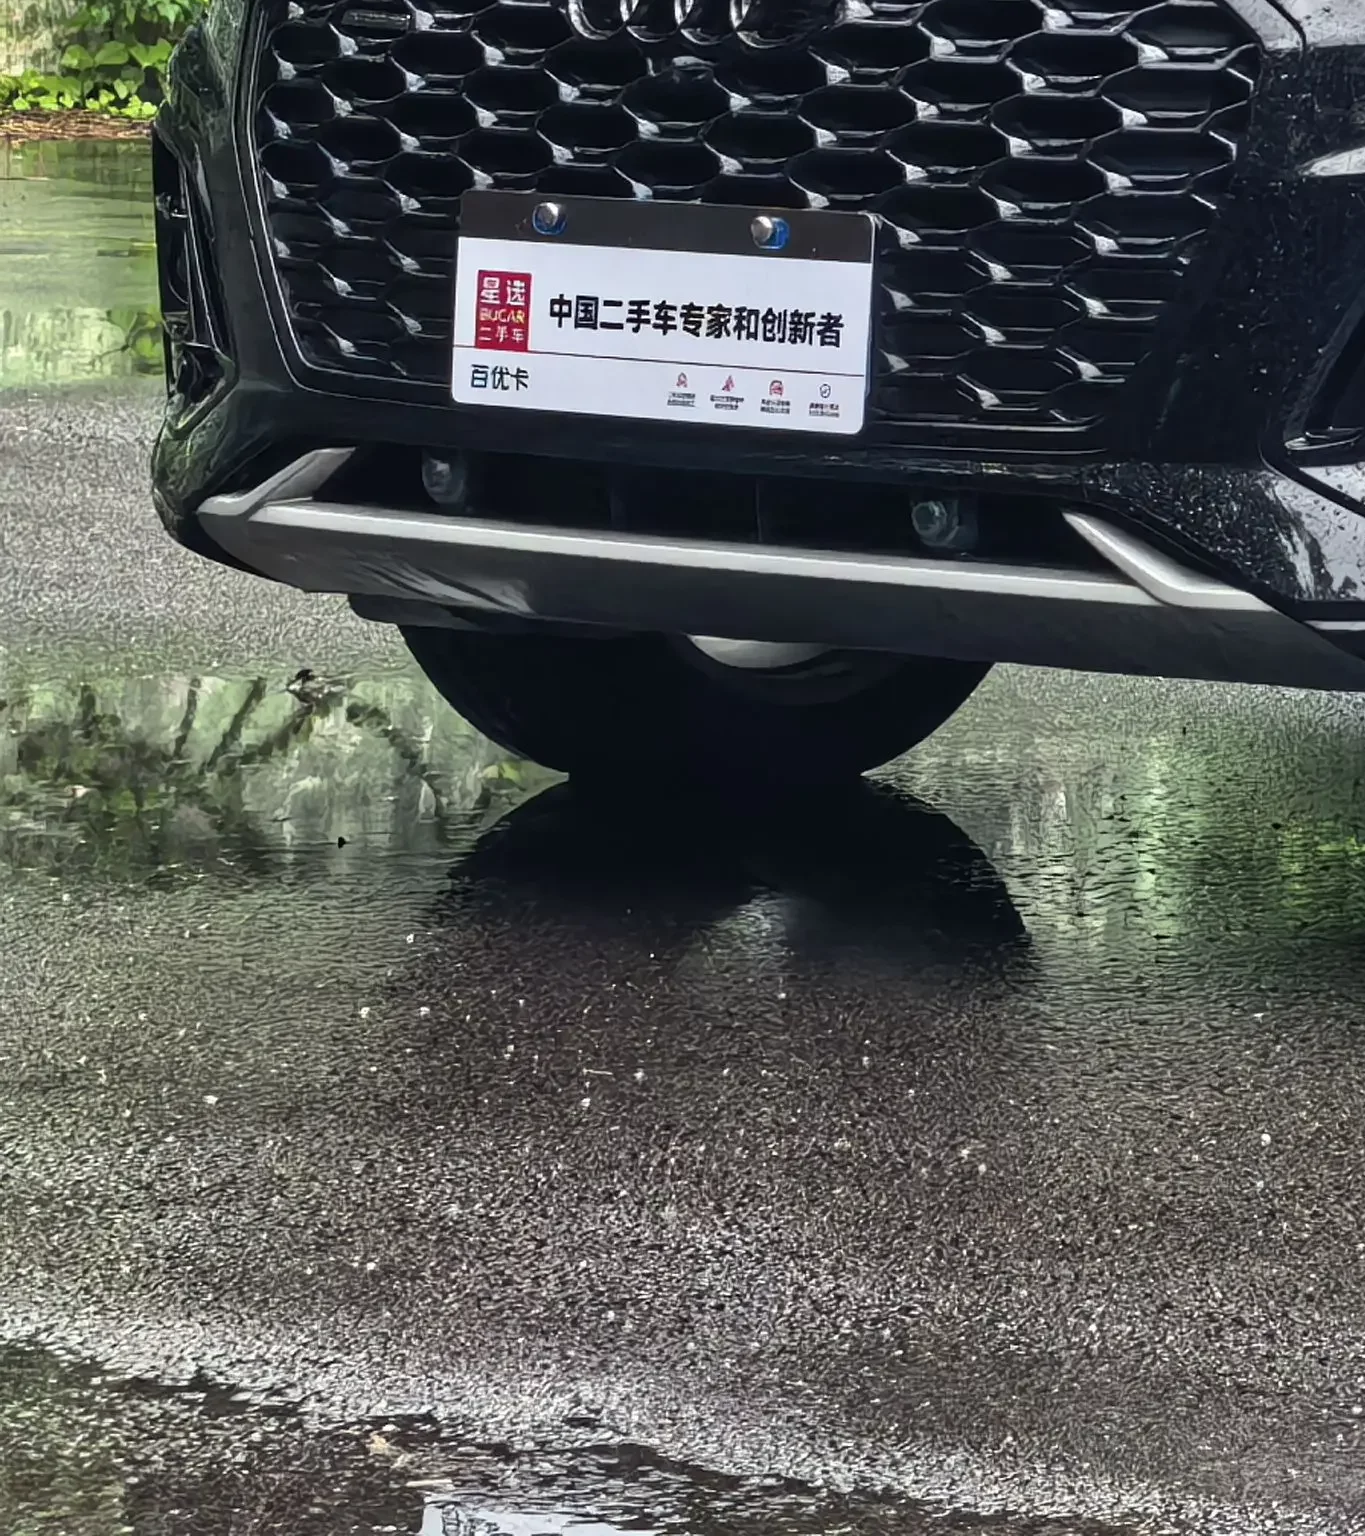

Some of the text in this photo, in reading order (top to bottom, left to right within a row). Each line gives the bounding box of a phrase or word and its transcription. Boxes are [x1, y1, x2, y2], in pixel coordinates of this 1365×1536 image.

[479, 277, 526, 306] 星选
[479, 308, 526, 324] BUCAR
[549, 294, 844, 348] 中国二手车专家和创新者
[478, 325, 525, 343] 二手车
[471, 364, 529, 391] 百优卡
